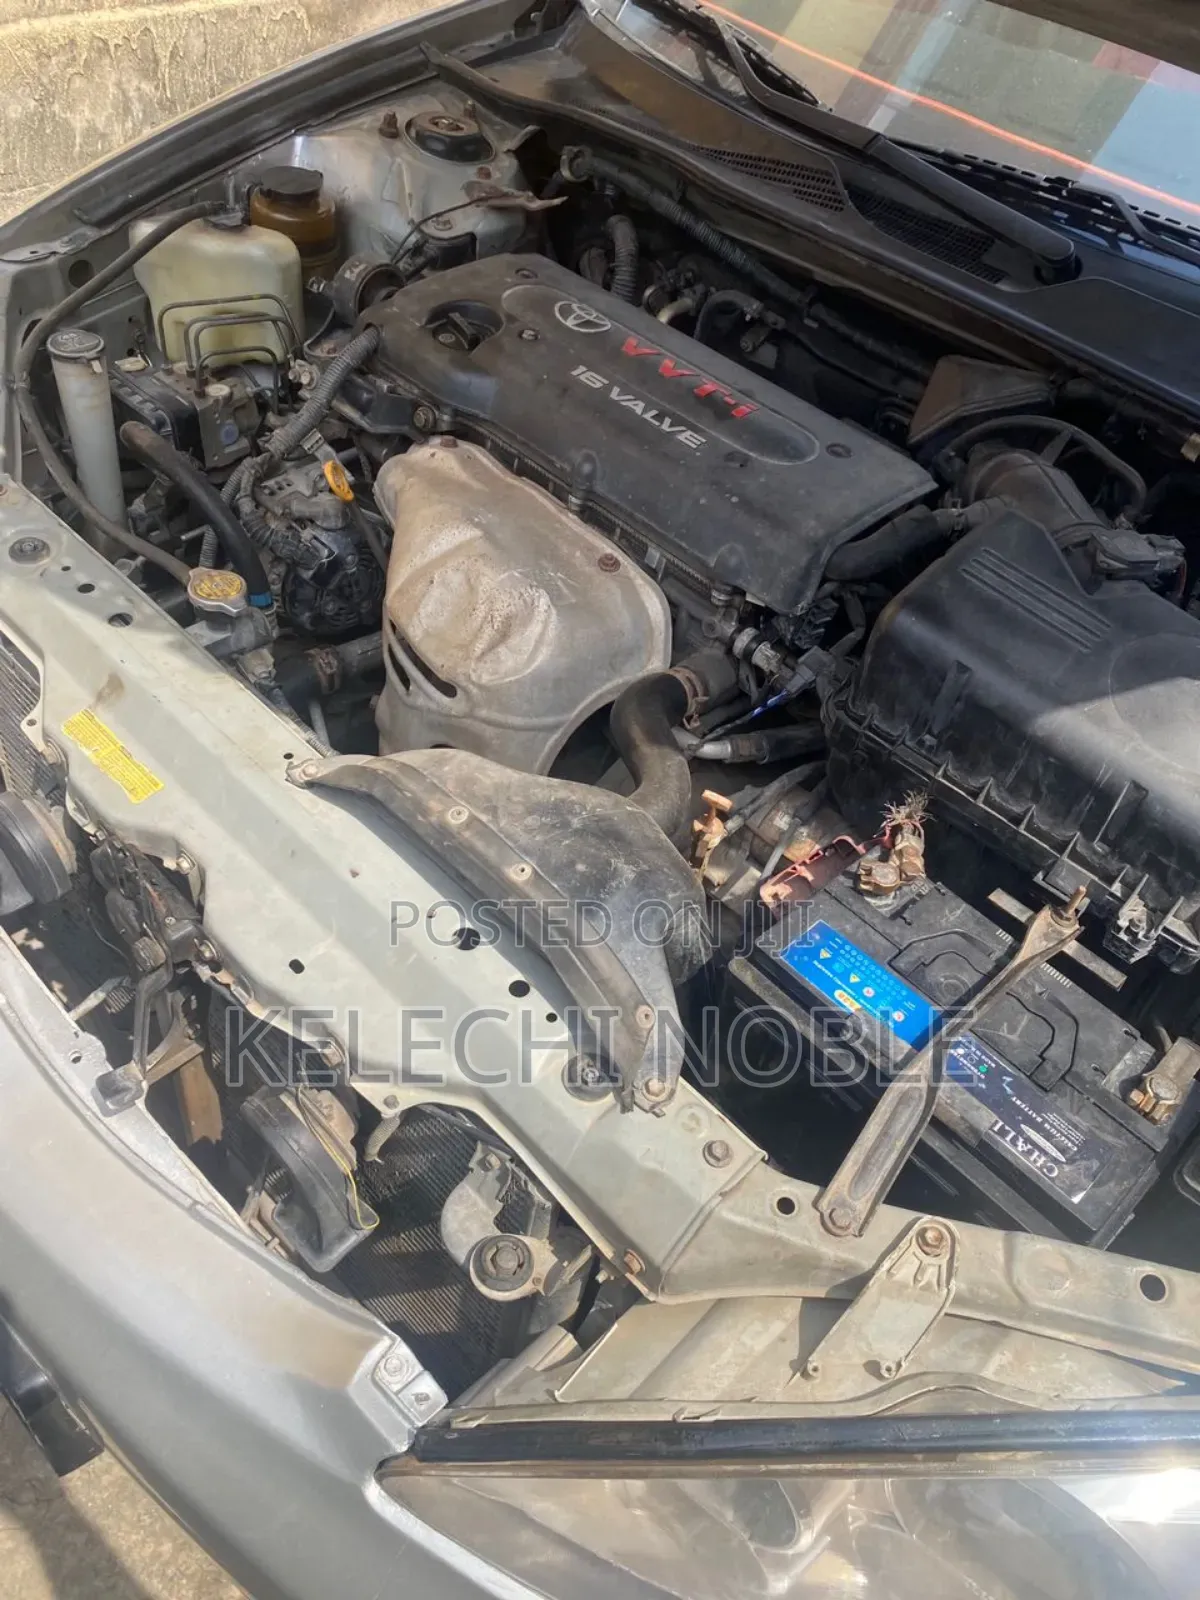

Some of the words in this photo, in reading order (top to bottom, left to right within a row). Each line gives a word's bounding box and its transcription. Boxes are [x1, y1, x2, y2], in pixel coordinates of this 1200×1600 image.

[571, 364, 609, 389] 16
[609, 386, 707, 448] VALVE
[1011, 1096, 1043, 1123] BATTERY
